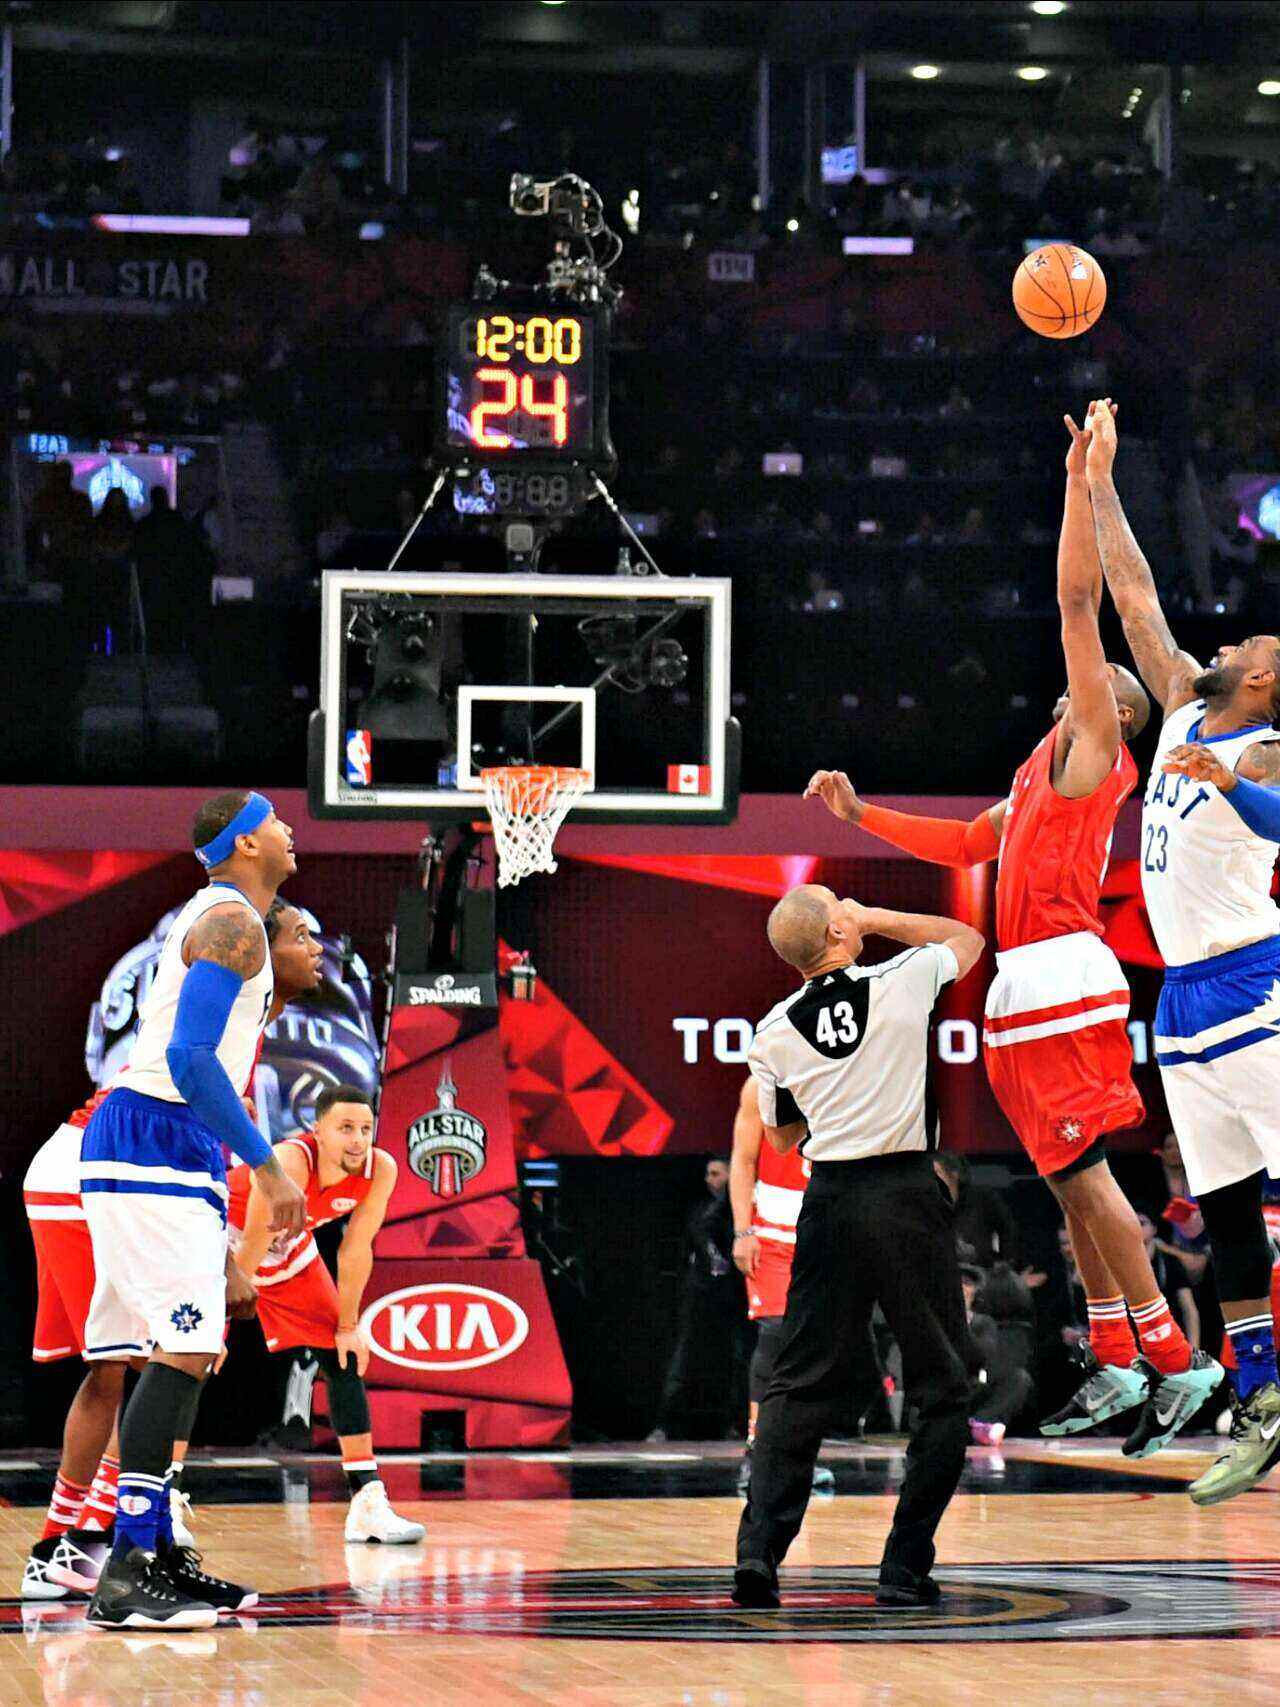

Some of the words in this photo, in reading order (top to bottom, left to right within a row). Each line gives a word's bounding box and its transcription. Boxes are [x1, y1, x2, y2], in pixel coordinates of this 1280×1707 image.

[20, 257, 84, 297] ALL
[118, 259, 209, 303] STAR
[476, 316, 581, 364] 12:00
[470, 368, 568, 447] 24
[1144, 770, 1211, 820] AST
[1144, 823, 1169, 873] 23
[409, 986, 482, 1005] SPALDING
[816, 1000, 859, 1048] 43
[388, 1302, 501, 1351] KIA
